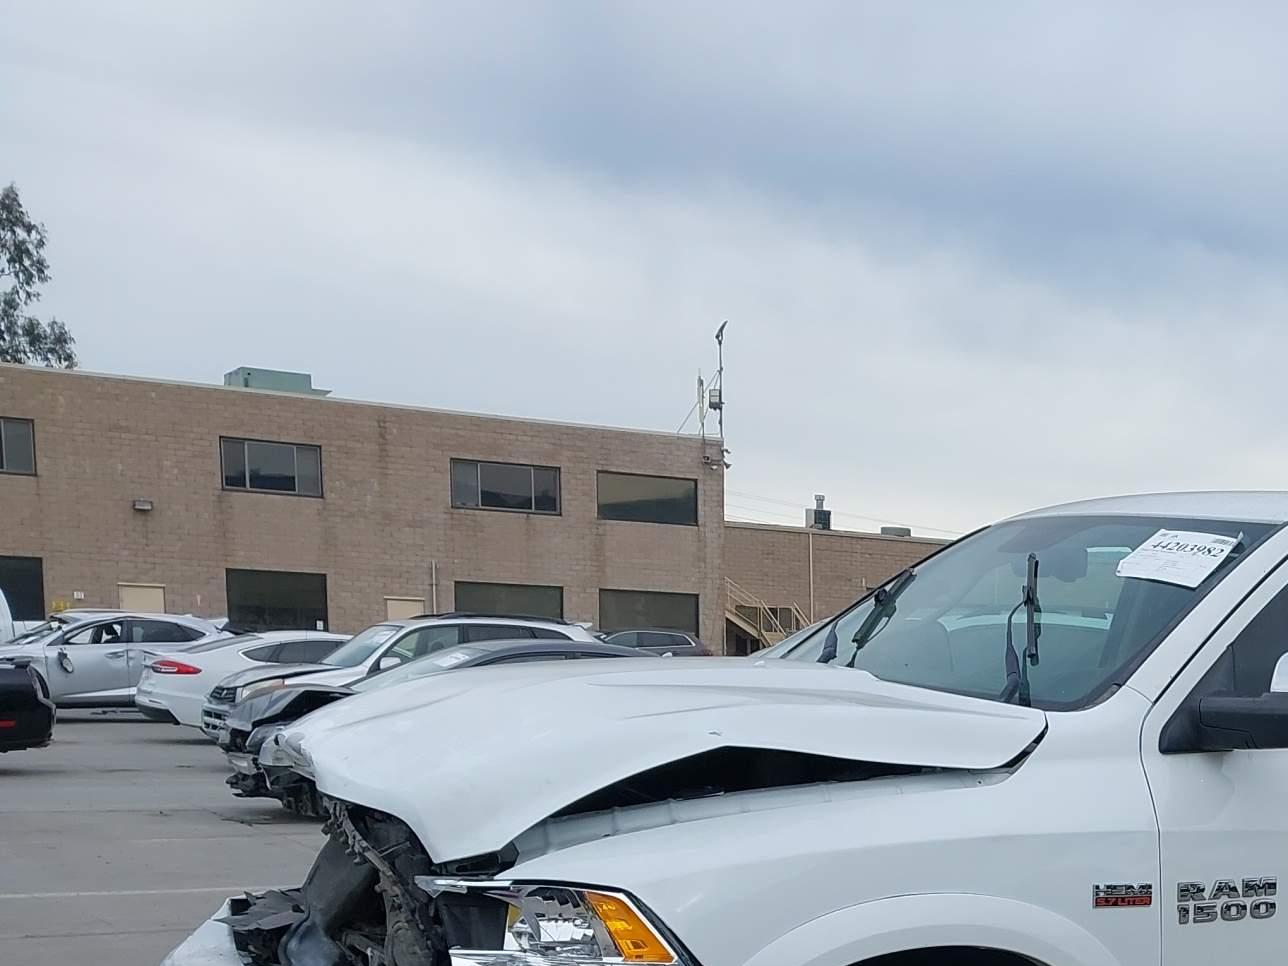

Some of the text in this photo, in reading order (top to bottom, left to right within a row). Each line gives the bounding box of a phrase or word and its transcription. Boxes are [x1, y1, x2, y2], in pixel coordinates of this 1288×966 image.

[1152, 540, 1225, 558] 44203982
[1177, 877, 1277, 902] RAM
[1097, 896, 1151, 906] 5.7 LITER
[1177, 899, 1277, 924] 1500
